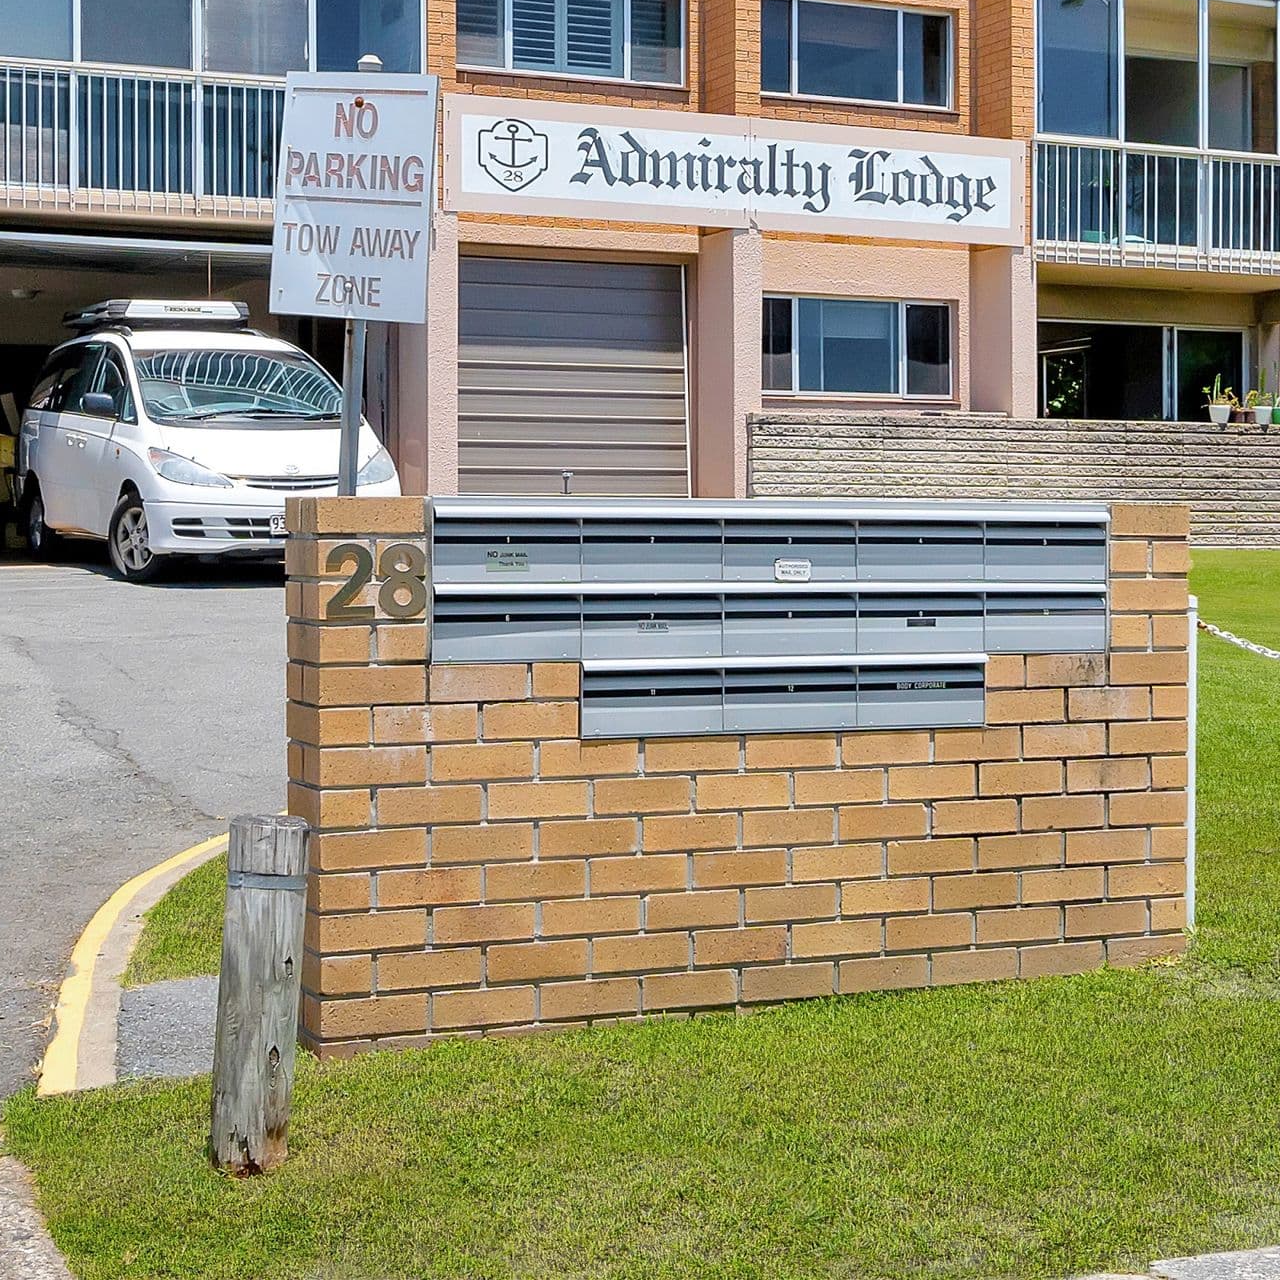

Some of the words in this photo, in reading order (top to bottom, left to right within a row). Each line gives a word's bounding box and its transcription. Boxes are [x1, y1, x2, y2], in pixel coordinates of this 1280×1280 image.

[334, 101, 379, 139] NO
[285, 150, 425, 193] PARKING
[503, 169, 524, 183] 28
[569, 127, 833, 213] Admiralty
[847, 148, 997, 223] Lodge
[282, 222, 341, 255] TOW
[349, 226, 421, 260] AWAY
[315, 272, 381, 308] ZONE
[325, 542, 427, 620] 28
